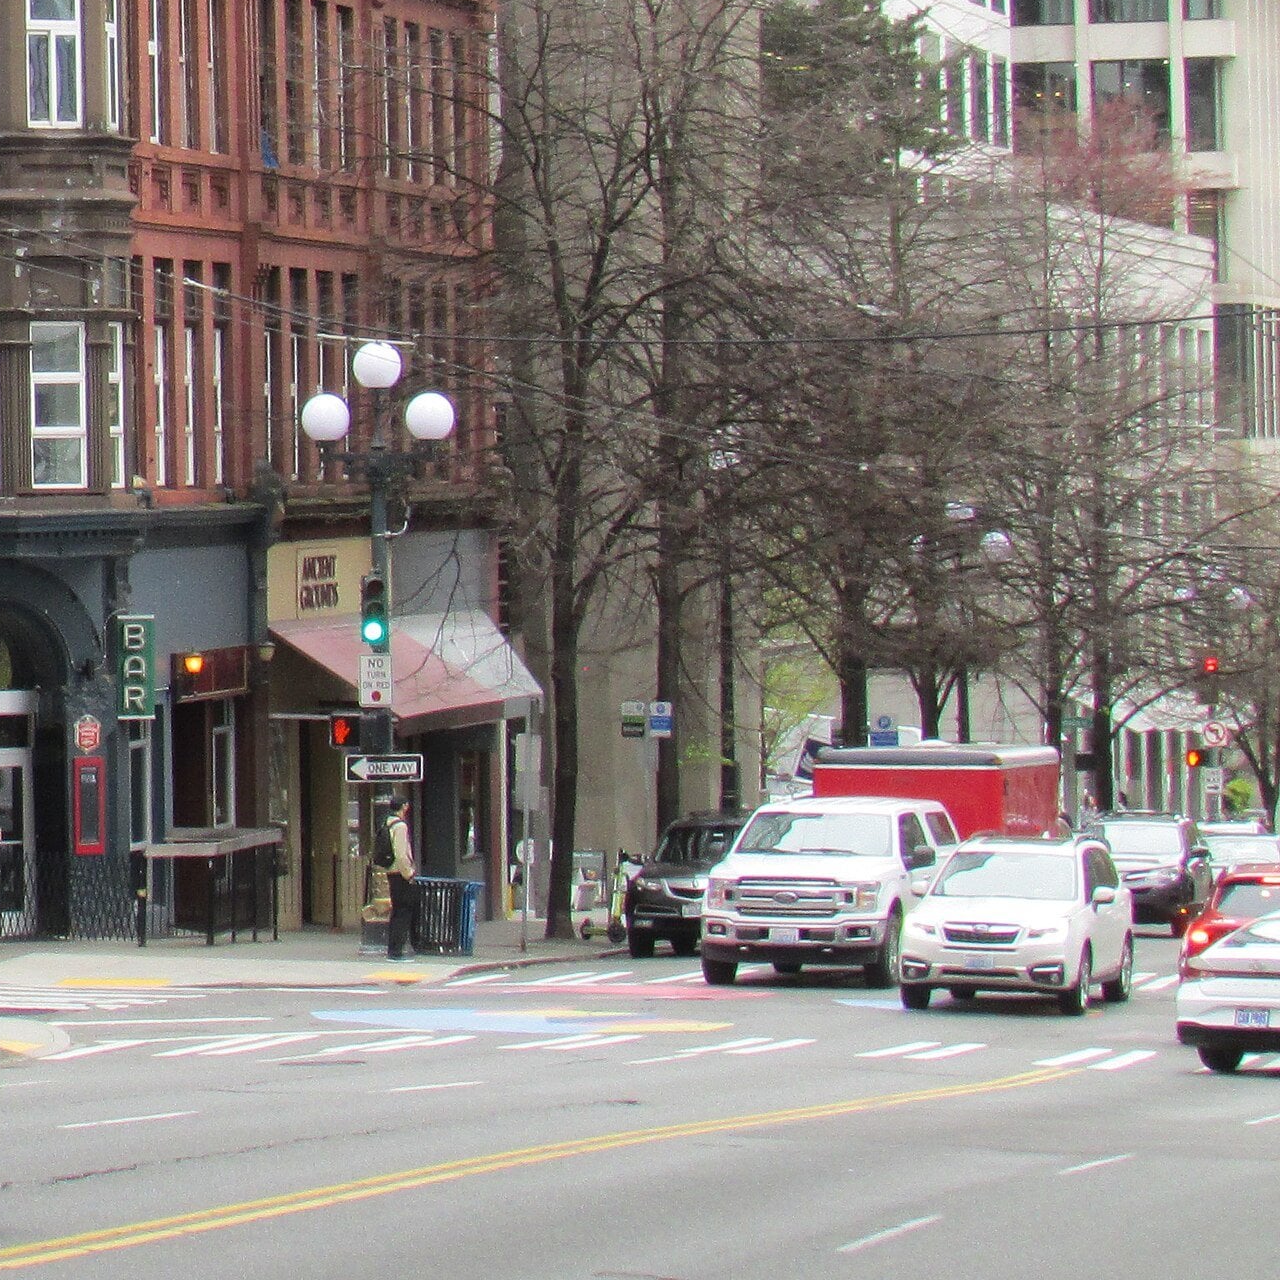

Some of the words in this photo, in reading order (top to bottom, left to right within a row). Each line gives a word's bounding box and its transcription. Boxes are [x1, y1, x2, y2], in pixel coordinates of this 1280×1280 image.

[123, 624, 147, 710] BAR
[368, 659, 384, 668] NO
[368, 763, 388, 774] ONE
[392, 763, 413, 773] WAY
